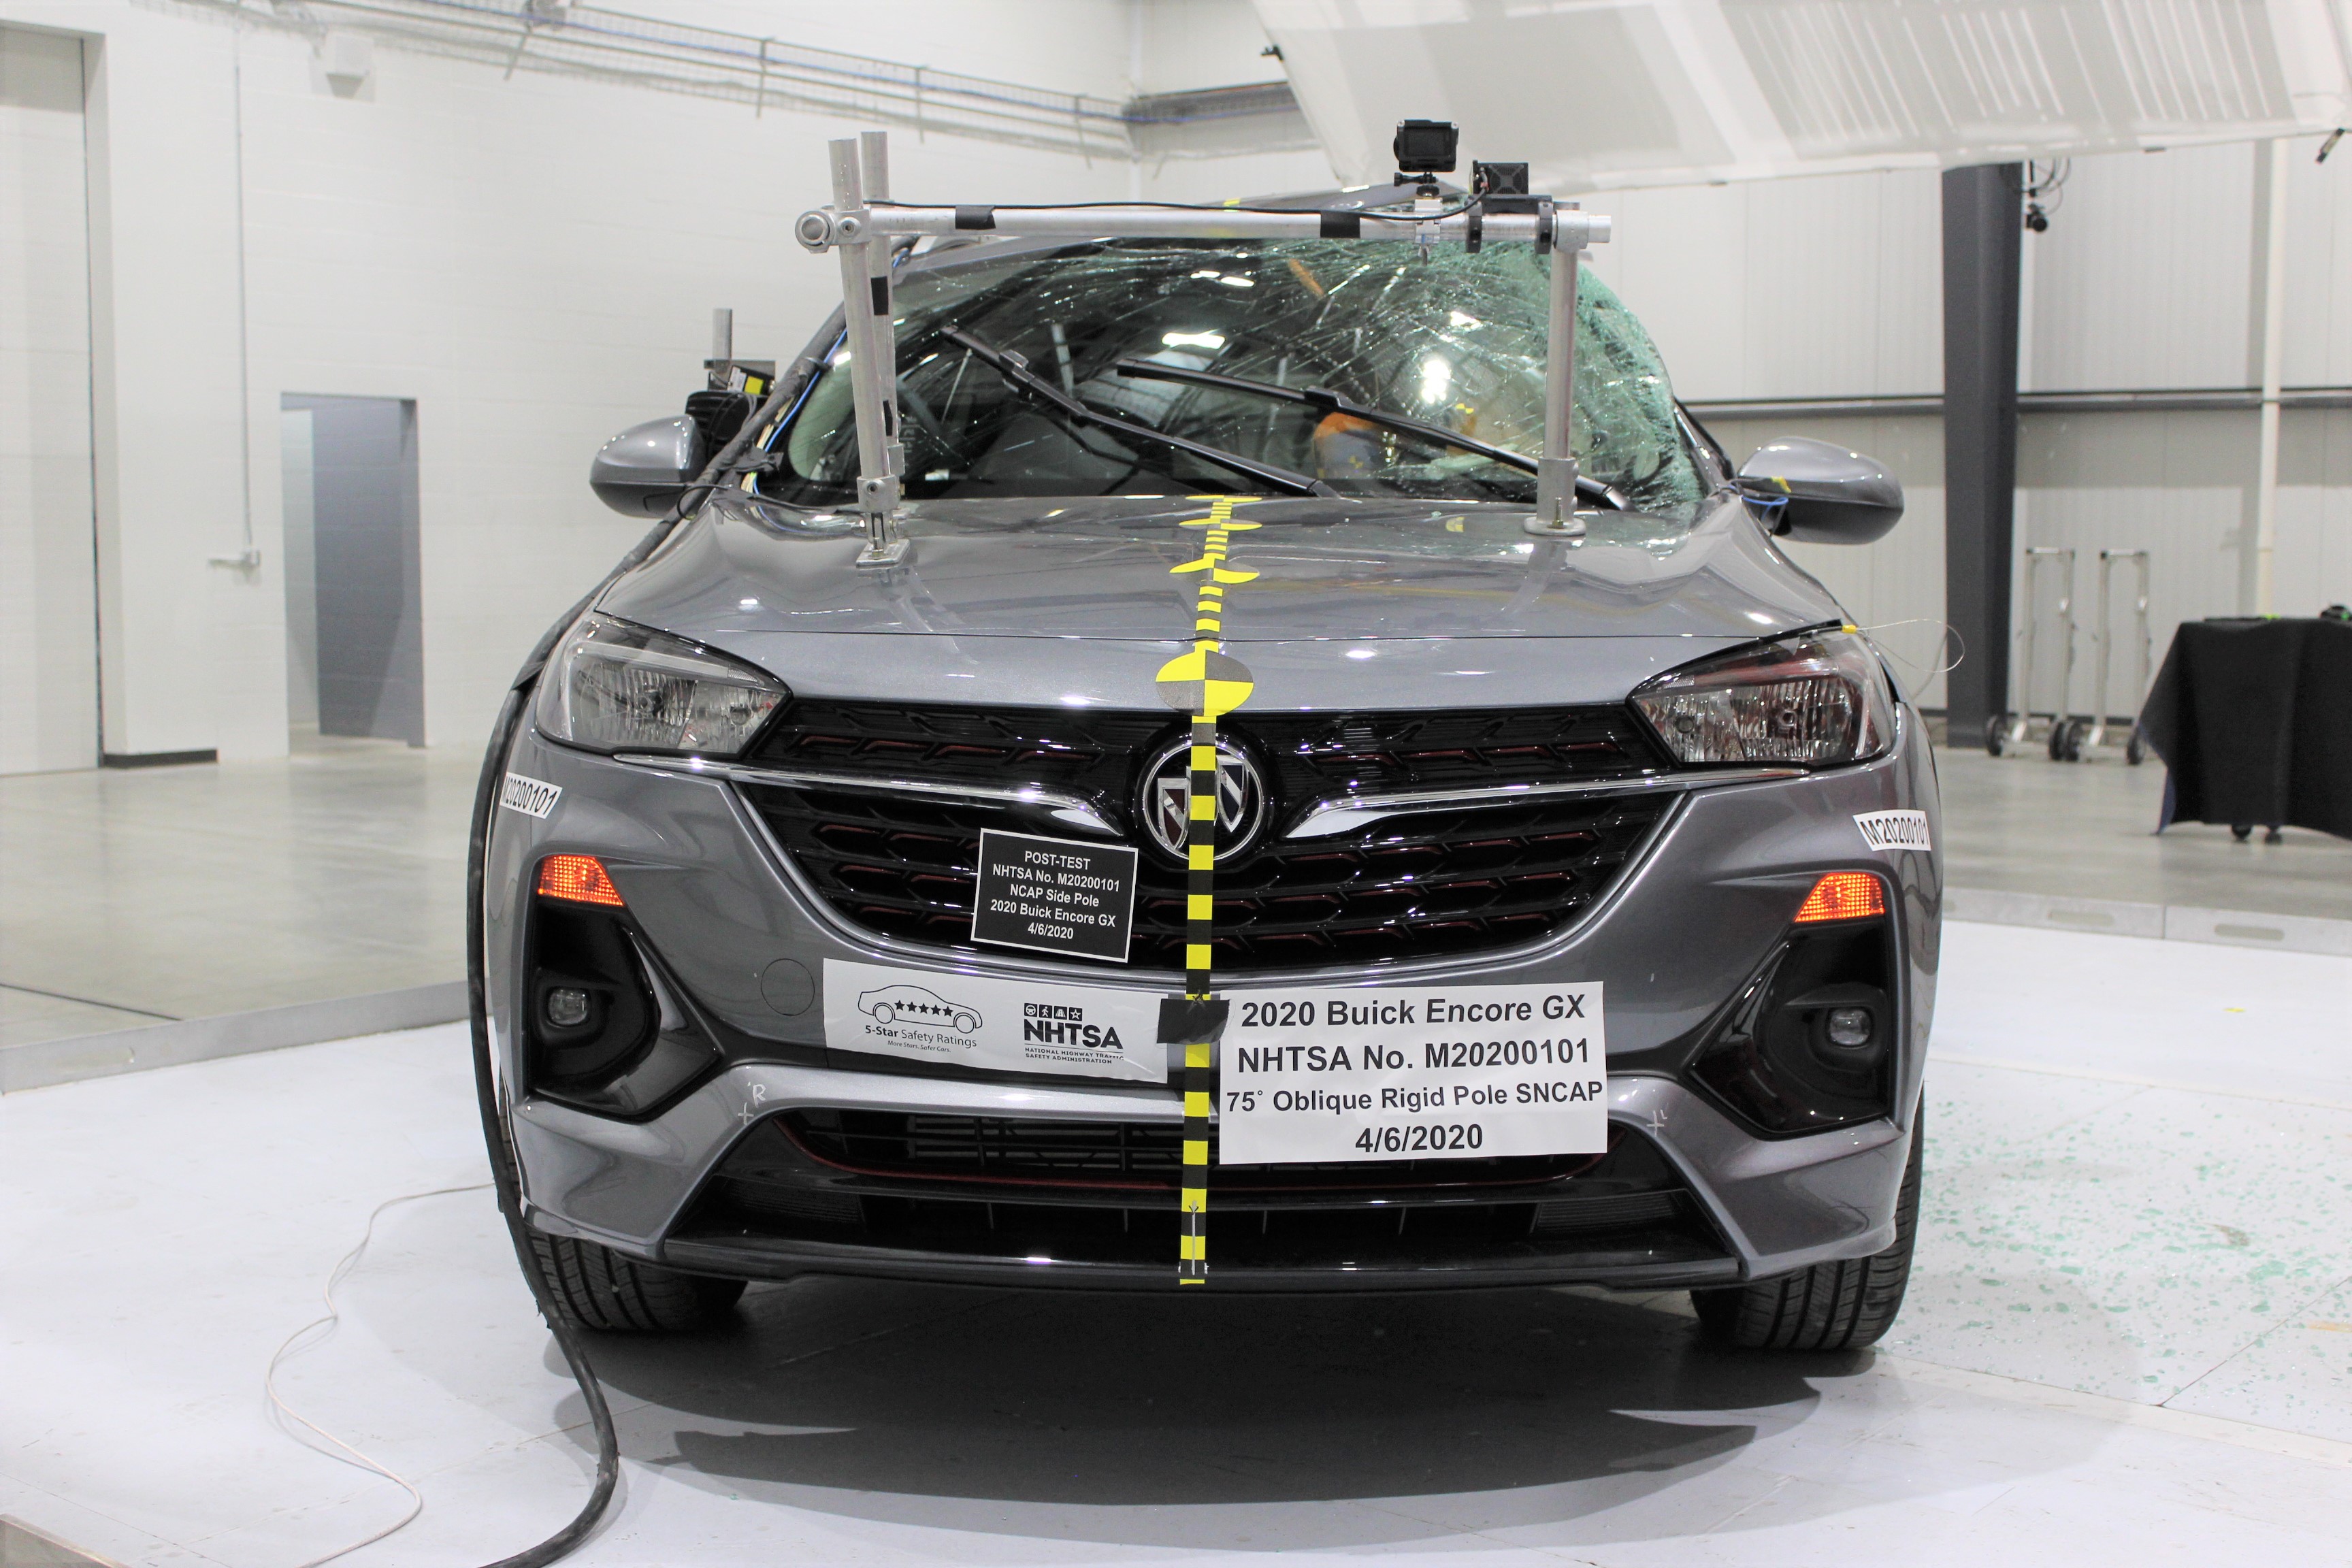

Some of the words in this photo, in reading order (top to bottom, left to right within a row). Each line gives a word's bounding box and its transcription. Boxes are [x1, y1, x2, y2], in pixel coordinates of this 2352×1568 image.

[1860, 817, 1929, 845] M20200101
[1025, 851, 1091, 870] POST-TEST
[993, 864, 1033, 881] NHTSA
[1036, 870, 1054, 883] No.
[1058, 873, 1119, 892] M20200101
[1010, 884, 1043, 898] NCAP
[1046, 889, 1071, 903] Side
[1074, 892, 1099, 906] Pole
[990, 899, 1017, 913] 2020
[1020, 903, 1051, 919] Buick
[1055, 908, 1094, 924] Encore
[1098, 914, 1116, 927] GX
[1028, 922, 1073, 939] 4/6/2020
[1241, 1001, 1315, 1027] 2020
[1328, 1000, 1415, 1026] Buick
[1426, 998, 1531, 1023] Encore
[1543, 994, 1585, 1019] GX
[866, 1025, 898, 1037] 5-Star
[901, 1029, 934, 1044] Safety
[936, 1034, 977, 1048] Ratings
[1024, 1019, 1124, 1049] NHTSA
[1052, 1056, 1112, 1064] ADMINISTRATION
[1239, 1046, 1352, 1073] NHTSA
[1364, 1045, 1413, 1070] No.
[1425, 1038, 1587, 1068] M20200101
[1227, 1090, 1263, 1111] 75°
[1273, 1090, 1371, 1115] Oblique
[1382, 1087, 1444, 1113] Rigid
[1454, 1085, 1507, 1105] Pole
[1516, 1081, 1602, 1103] SNCAP
[1356, 1124, 1482, 1153] 4/6/2020
